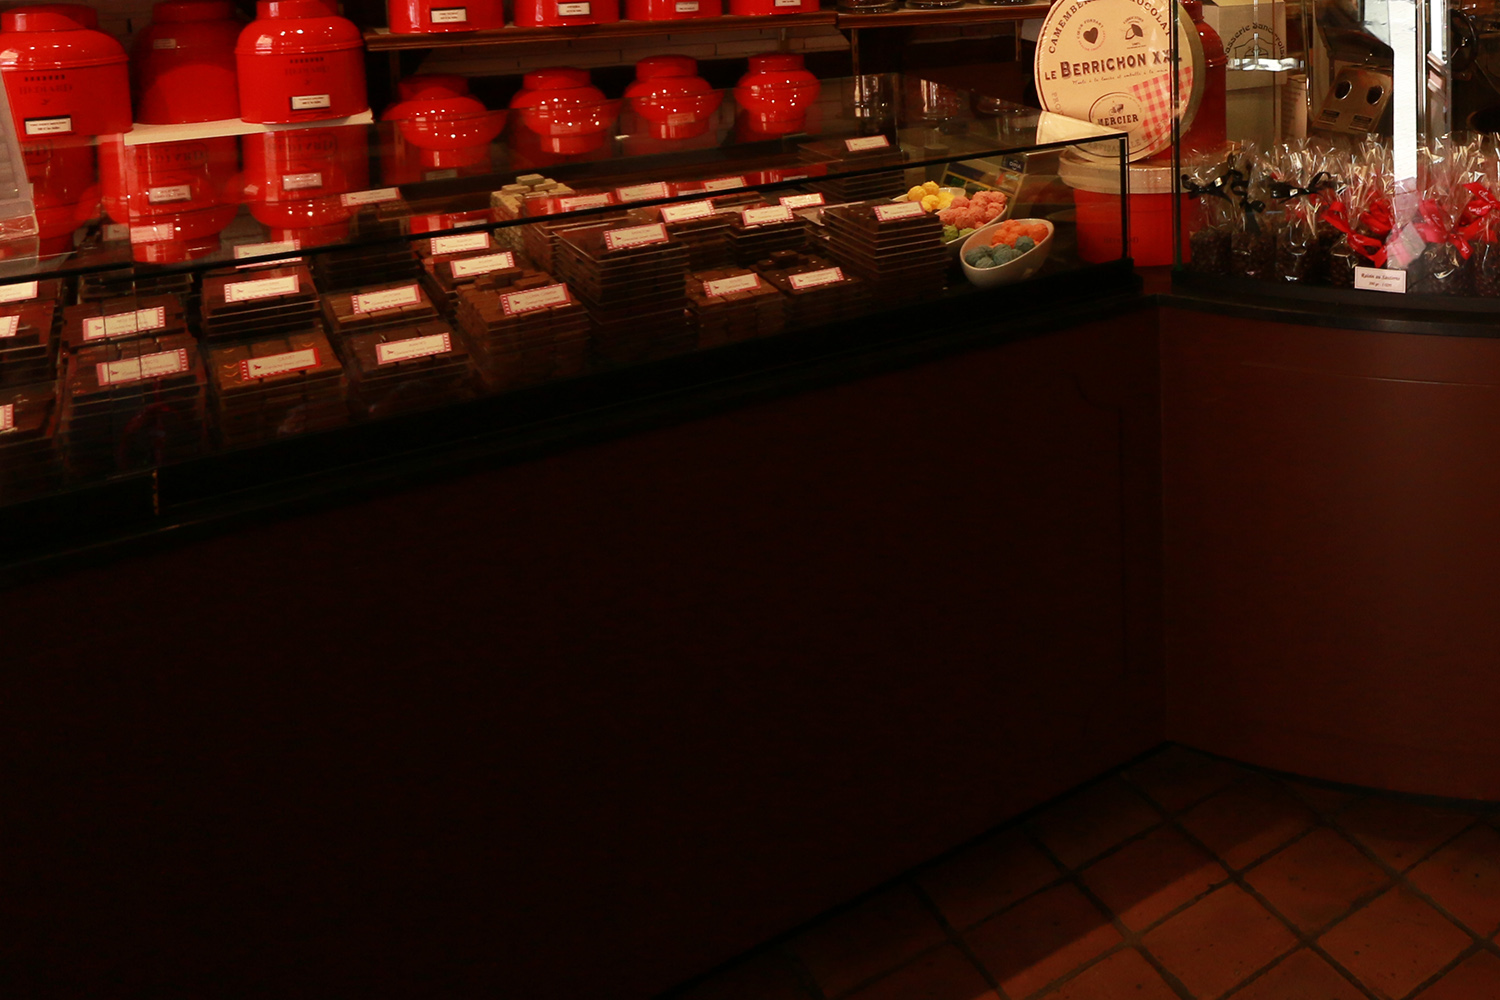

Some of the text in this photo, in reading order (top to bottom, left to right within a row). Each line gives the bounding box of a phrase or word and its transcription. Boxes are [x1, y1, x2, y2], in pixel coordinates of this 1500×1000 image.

[1048, 0, 1094, 54] CAMEMBE
[1044, 70, 1057, 81] LE
[1059, 52, 1147, 79] BERRICHON
[1097, 113, 1139, 127] MERCIER
